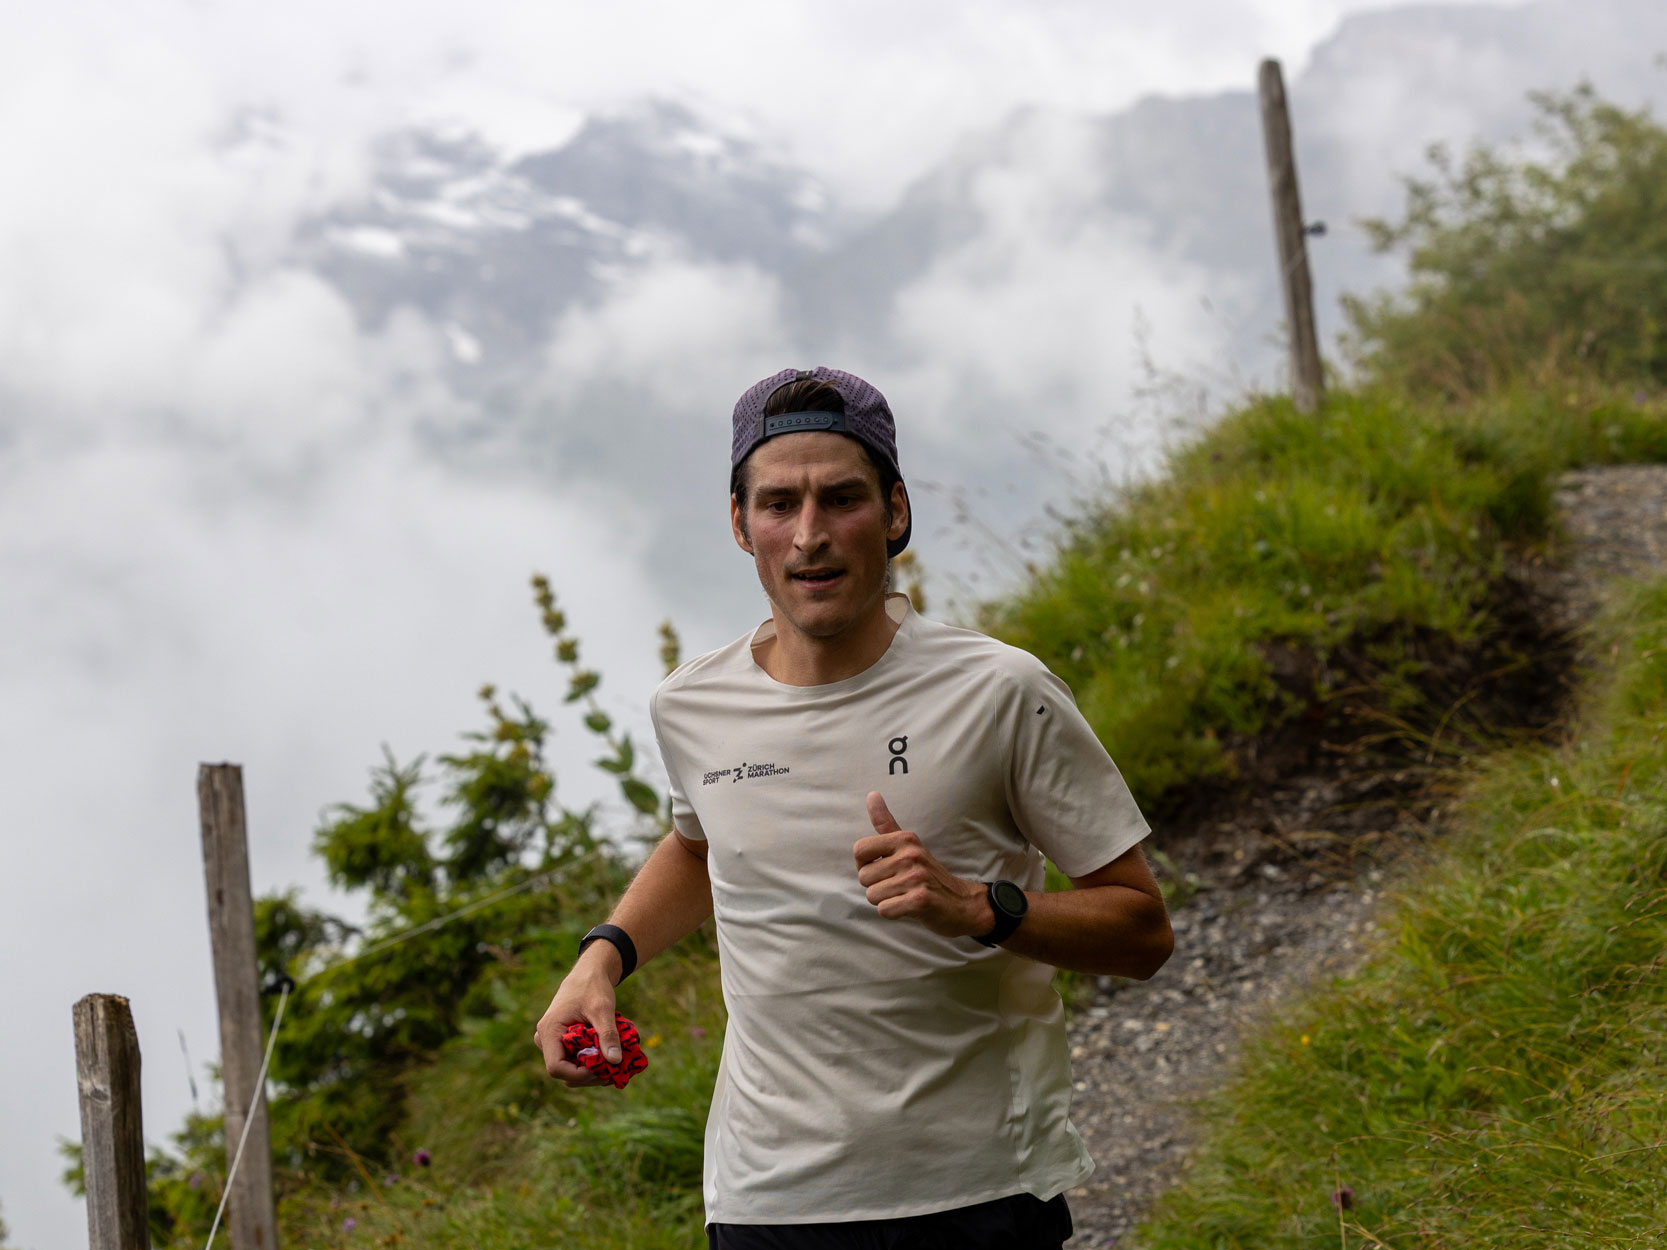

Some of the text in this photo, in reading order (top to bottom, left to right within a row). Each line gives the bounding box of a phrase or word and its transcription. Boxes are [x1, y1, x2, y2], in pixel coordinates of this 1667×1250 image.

[747, 763, 775, 773] ZÜRICH
[747, 767, 790, 779] MARATHON
[702, 777, 719, 785] SPORT
